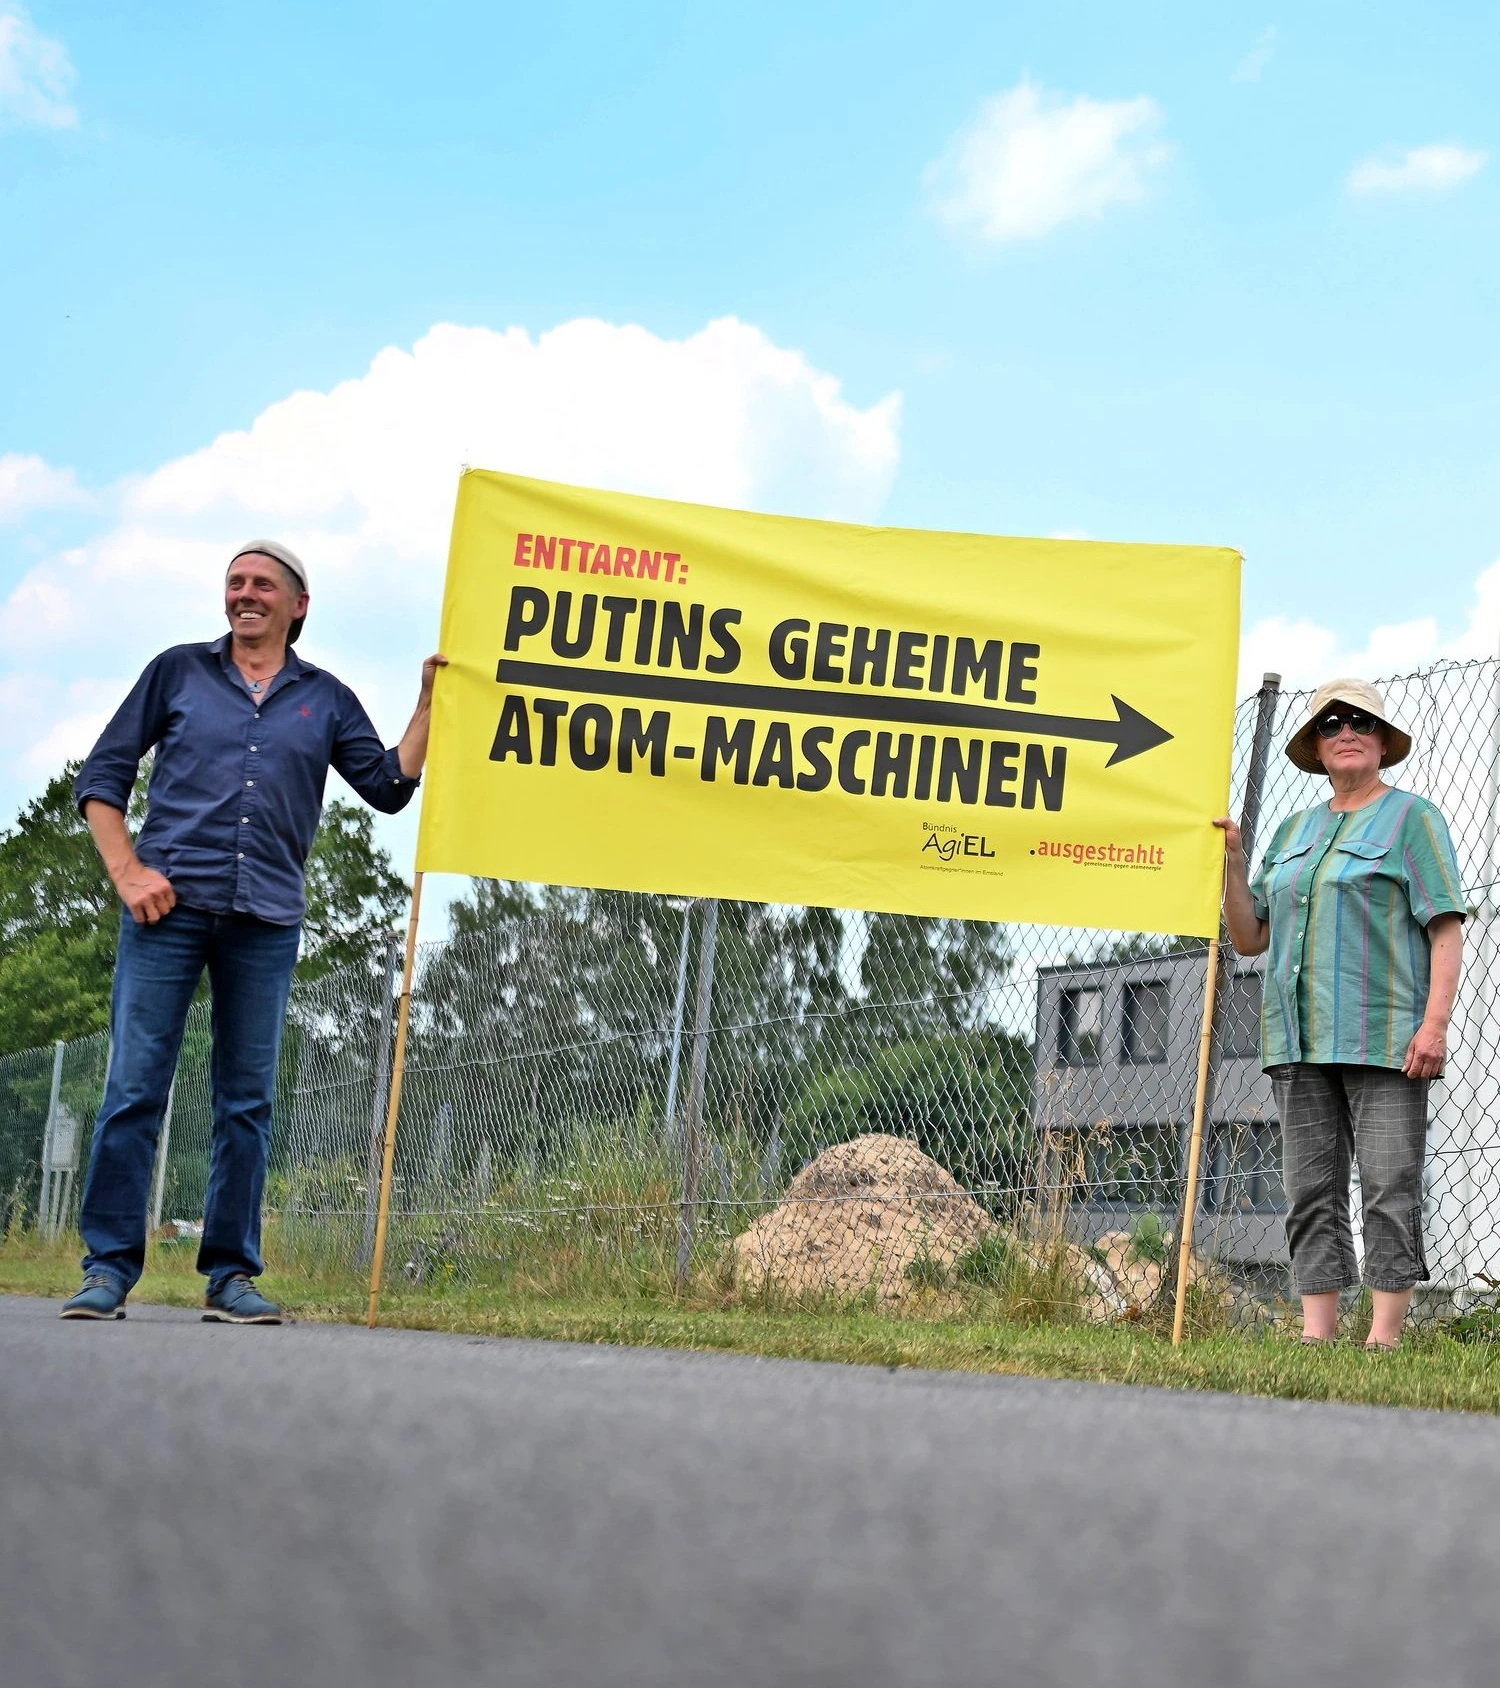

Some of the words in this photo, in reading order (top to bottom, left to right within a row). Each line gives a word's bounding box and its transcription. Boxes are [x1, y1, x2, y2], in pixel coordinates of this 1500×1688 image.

[513, 533, 689, 586] ENTTARNT:
[503, 586, 743, 675] PUTINS
[769, 618, 1041, 706] GEHEIME
[488, 694, 1068, 813] ATOM-MASCHINEN
[922, 822, 957, 833] Bündnis
[922, 833, 995, 861] AgiEL
